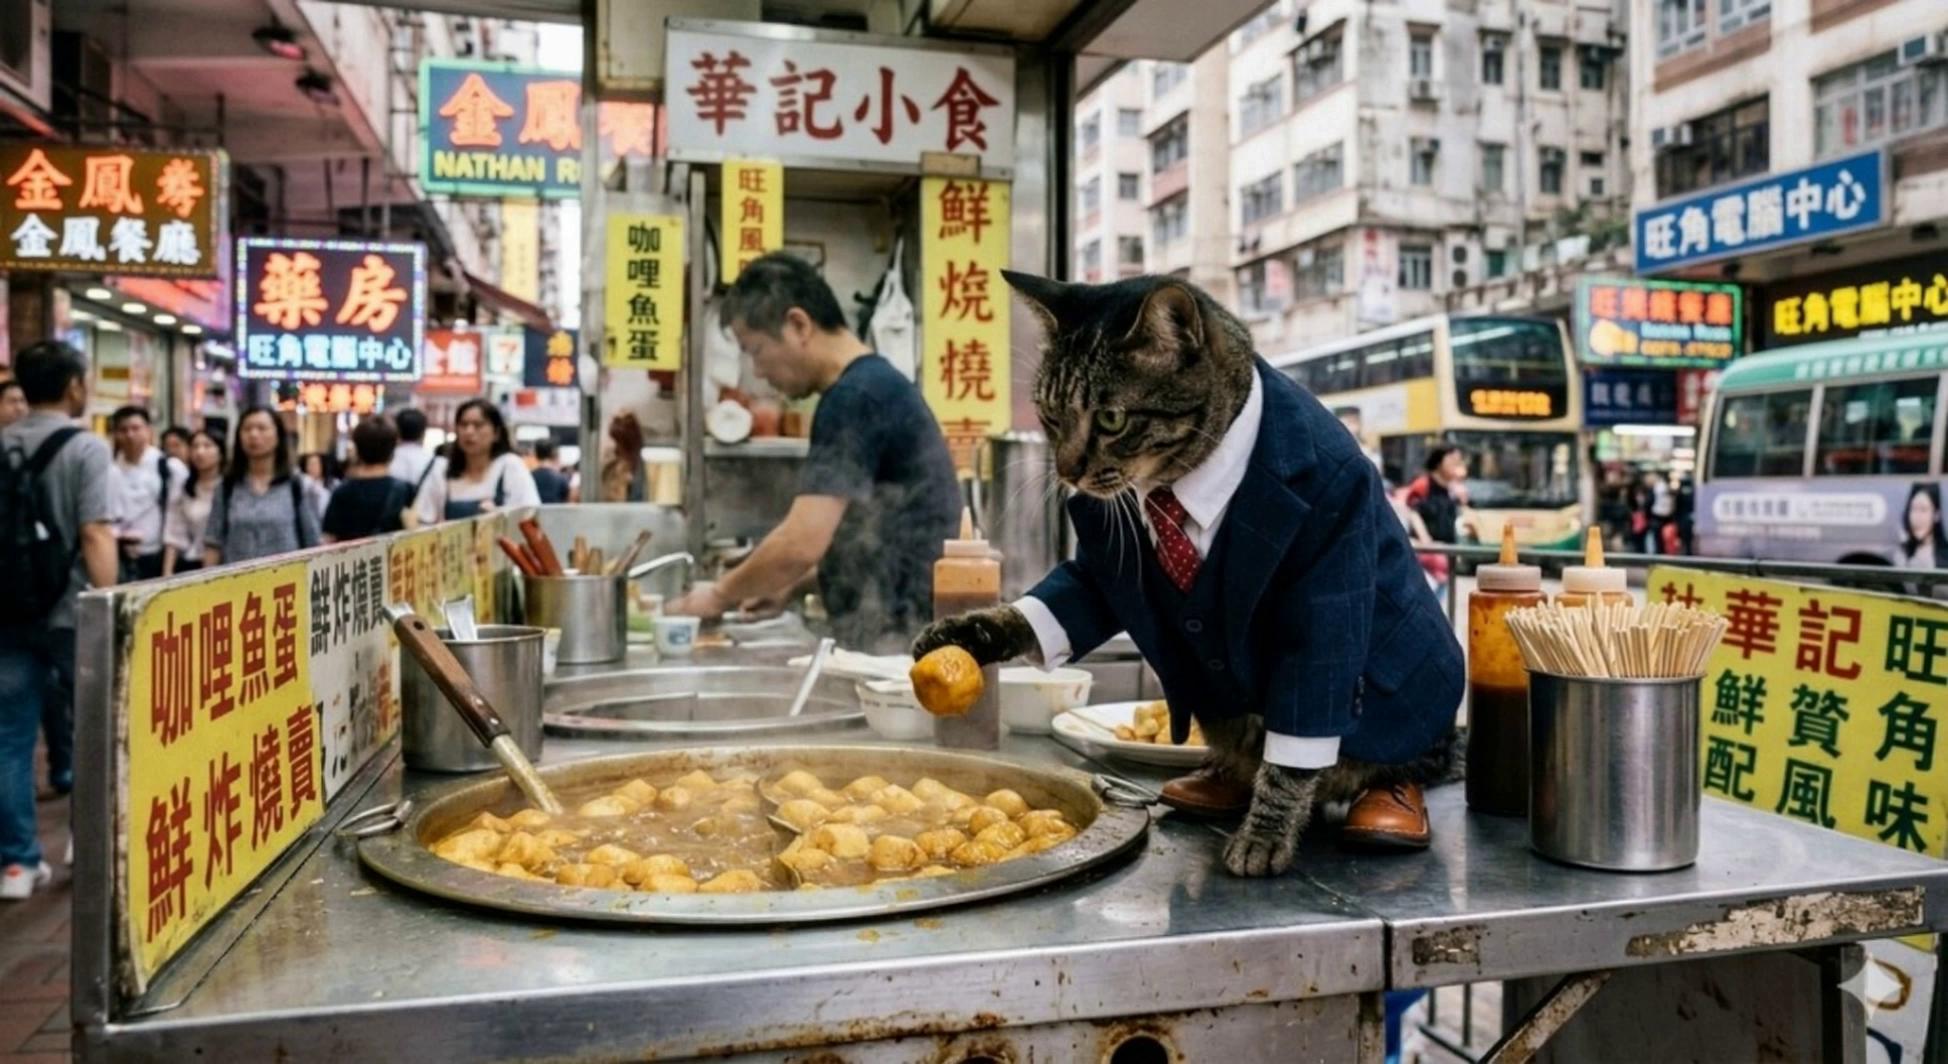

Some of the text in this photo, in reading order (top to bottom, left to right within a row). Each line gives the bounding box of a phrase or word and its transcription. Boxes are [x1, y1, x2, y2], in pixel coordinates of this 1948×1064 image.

[686, 50, 1001, 152] 華記小食
[434, 150, 546, 182] NATHAN
[1644, 168, 1866, 259] 旺角電腦中心
[10, 212, 202, 265] 金鳳餐廳
[738, 167, 768, 270] 旺角風
[253, 251, 408, 332] 藥房
[627, 221, 661, 360] 咖哩魚蛋
[150, 581, 298, 748] 咖哩魚蛋
[145, 704, 317, 943] 鮮炸燒賣
